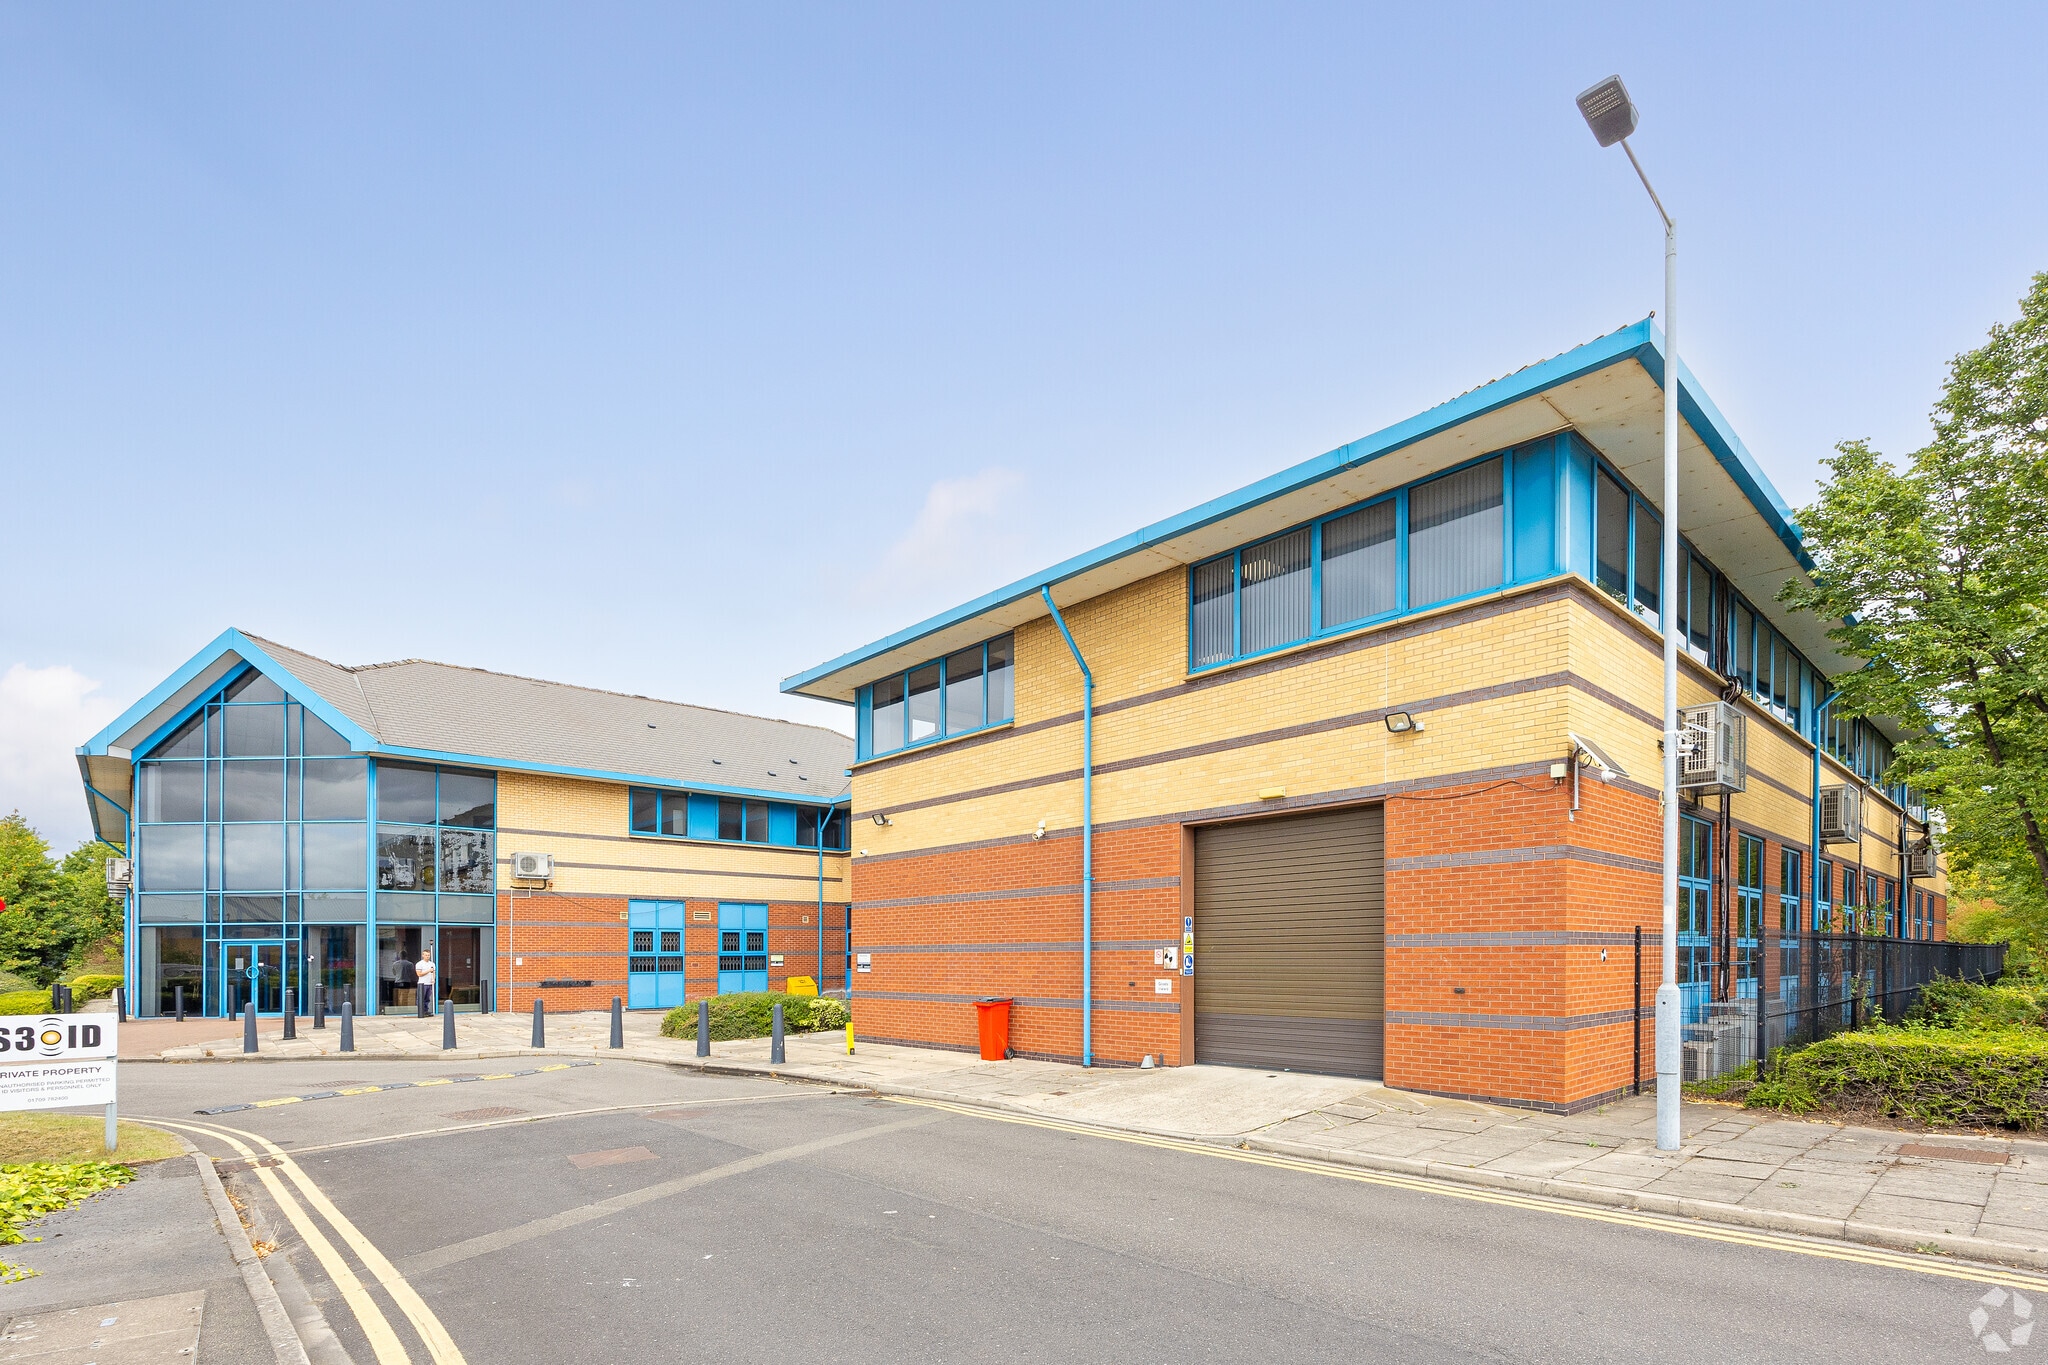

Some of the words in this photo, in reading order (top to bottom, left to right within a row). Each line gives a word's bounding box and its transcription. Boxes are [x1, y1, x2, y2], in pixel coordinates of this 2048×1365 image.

[68, 1025, 101, 1048] ID
[0, 1070, 39, 1079] RIVATE
[42, 1066, 102, 1076] PROPERTY
